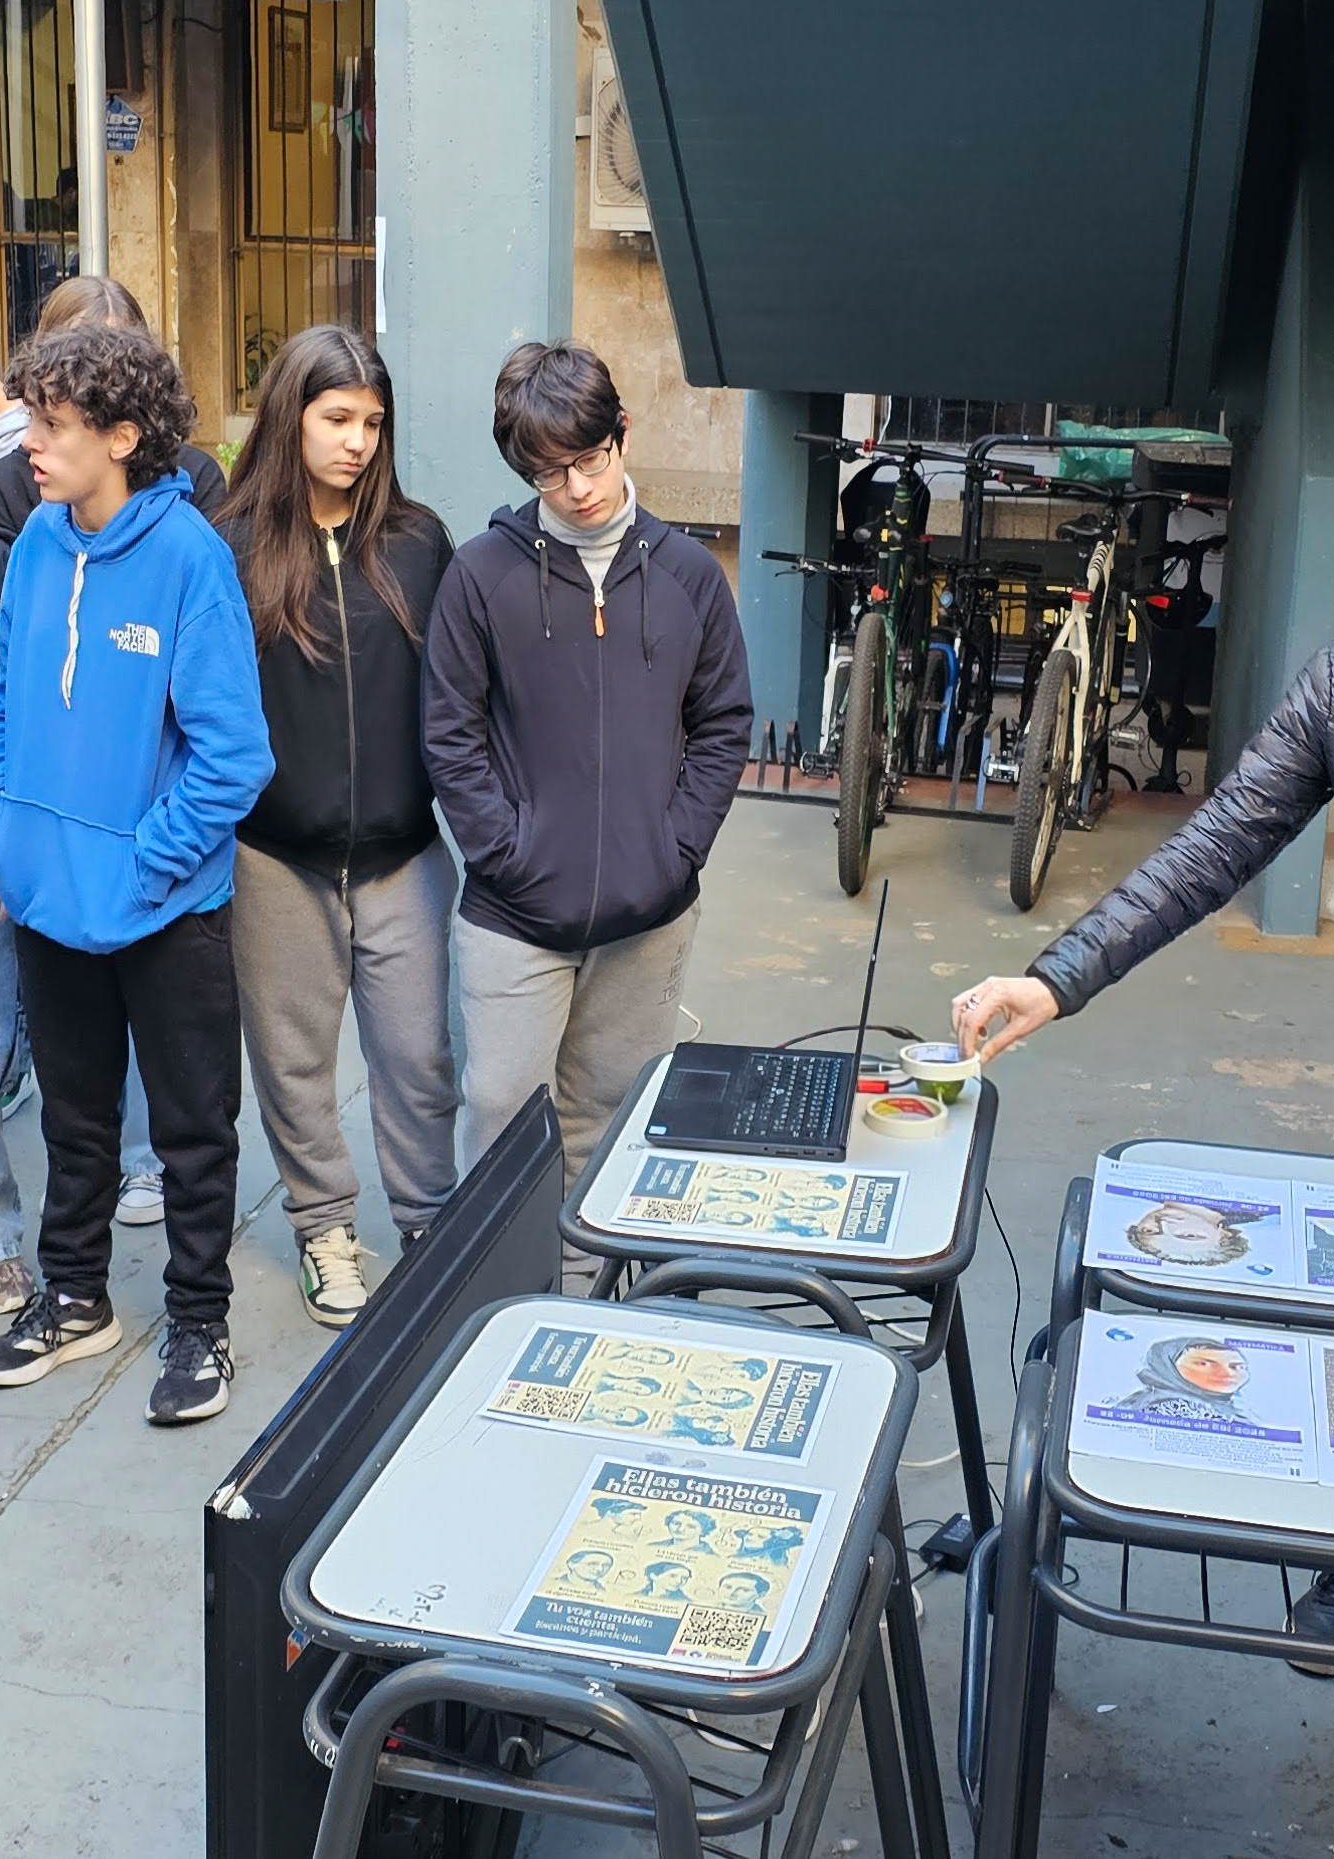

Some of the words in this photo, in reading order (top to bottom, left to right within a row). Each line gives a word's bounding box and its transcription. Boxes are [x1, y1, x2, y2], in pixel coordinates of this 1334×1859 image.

[109, 628, 146, 644] NORTH
[126, 623, 146, 635] THE
[117, 640, 146, 653] FACE
[622, 1468, 680, 1489] Ellas
[686, 1478, 787, 1504] también
[605, 1478, 702, 1506] hicieron
[708, 1493, 801, 1520] historia
[546, 1601, 563, 1614] Tu
[567, 1605, 592, 1617] voz
[594, 1610, 653, 1628] también
